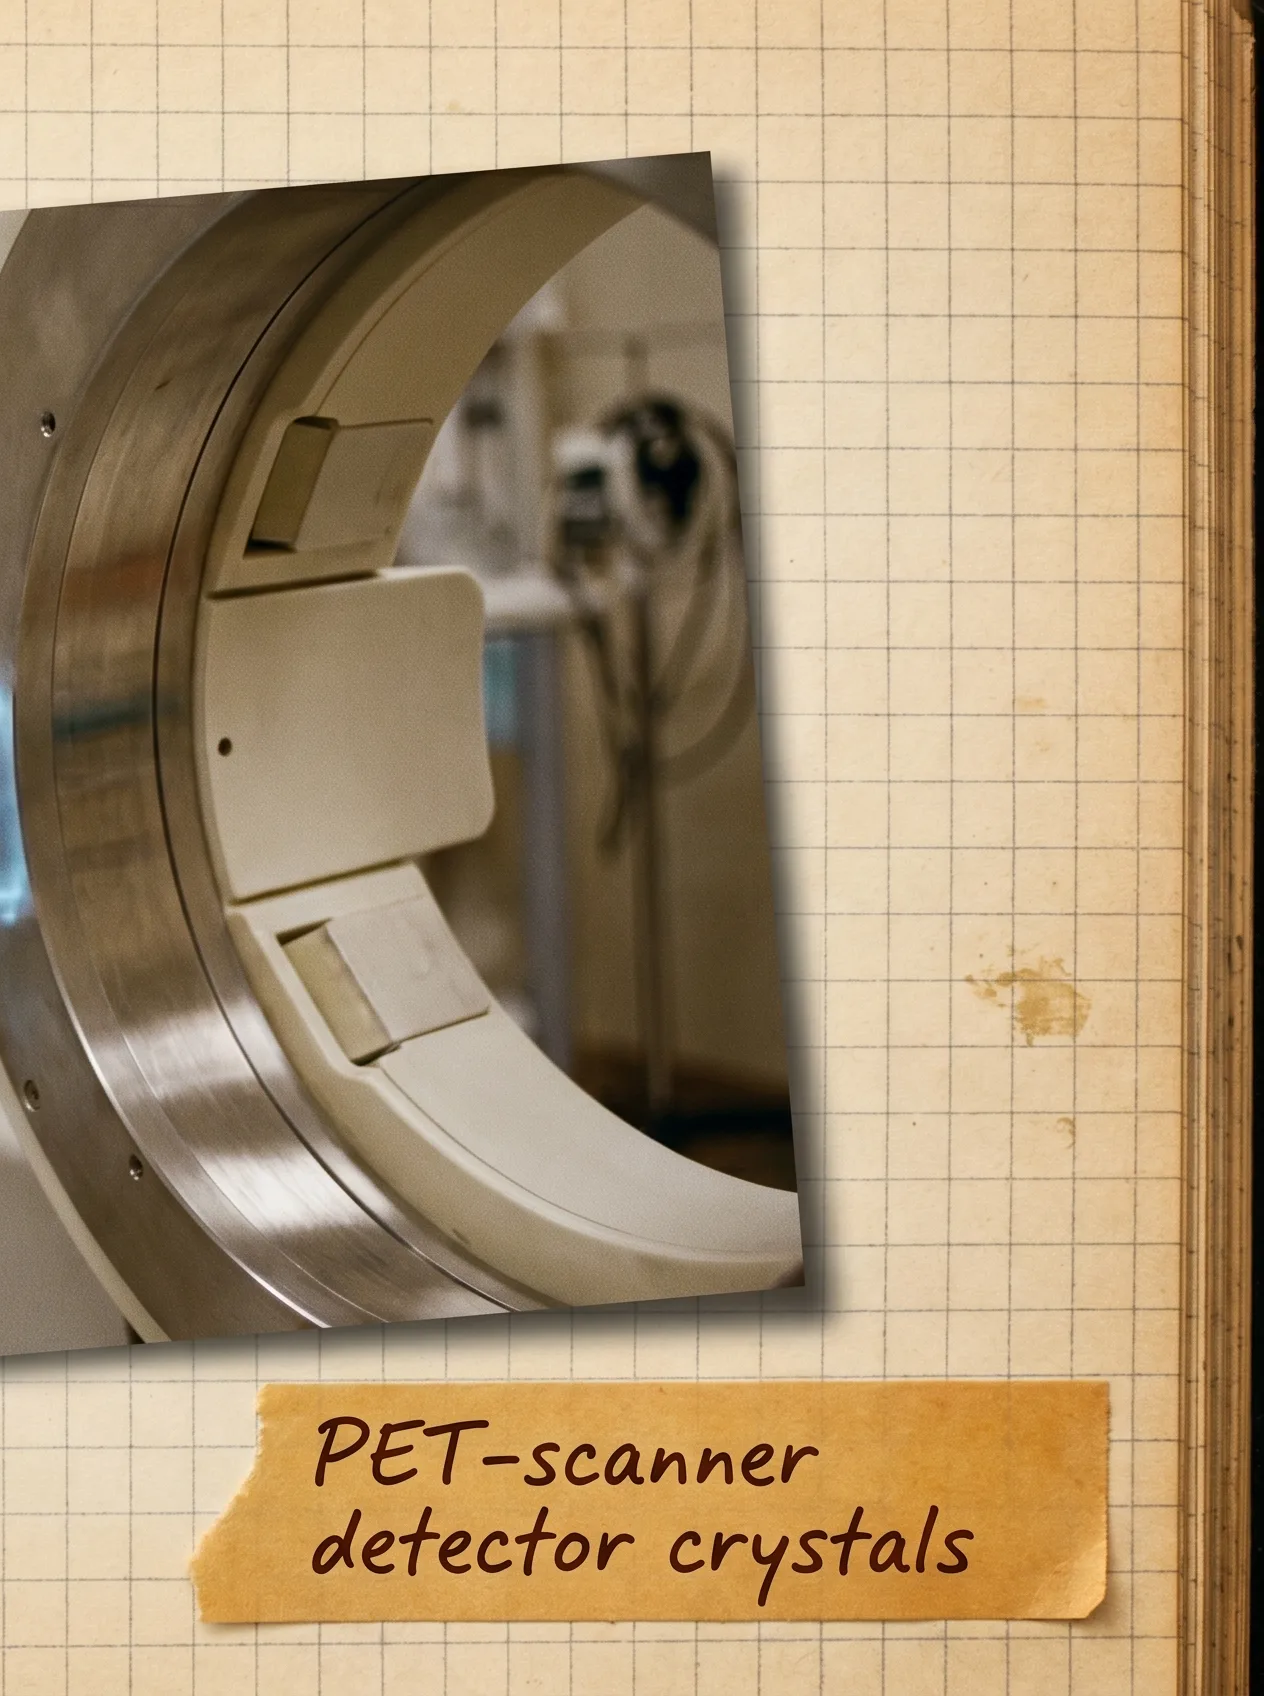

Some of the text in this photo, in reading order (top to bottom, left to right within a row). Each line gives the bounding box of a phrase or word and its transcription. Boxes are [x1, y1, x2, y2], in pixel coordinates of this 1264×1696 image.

[314, 1416, 820, 1487] PET-scanner
[311, 1504, 975, 1607] detector crystals
